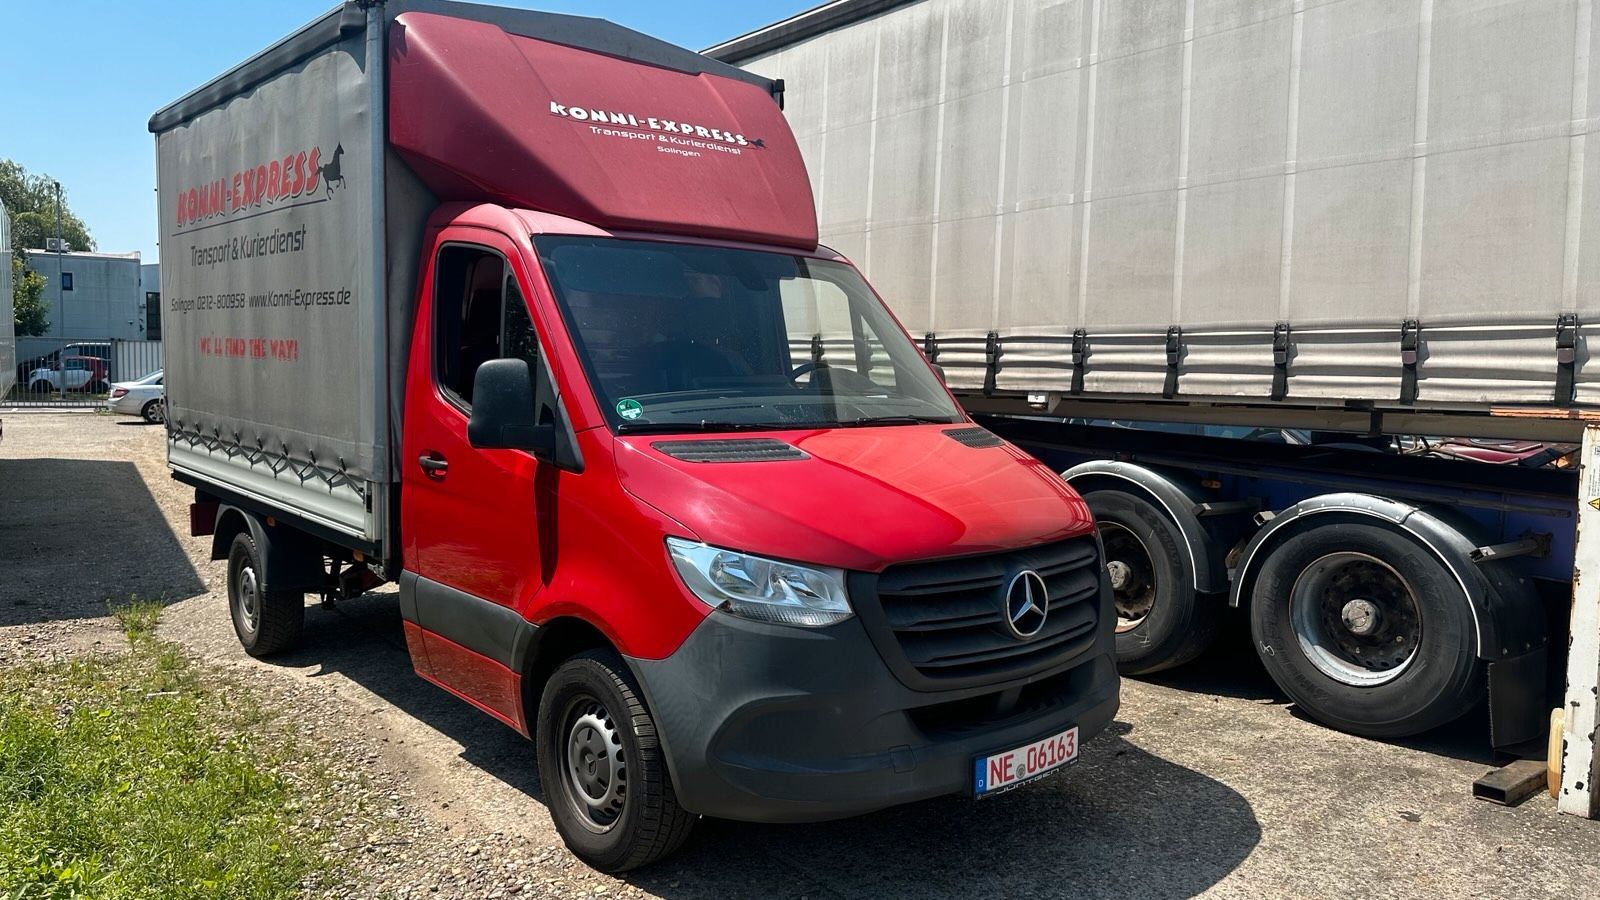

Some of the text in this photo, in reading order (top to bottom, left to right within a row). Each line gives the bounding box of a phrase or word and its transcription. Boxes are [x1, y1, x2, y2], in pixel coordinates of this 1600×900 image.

[550, 100, 751, 146] KONNI-EXPRESS
[589, 125, 742, 155] Transport & Kurierdienst
[656, 145, 701, 158] Solingen
[176, 145, 322, 228] KONNI-EXPRESS
[191, 224, 307, 270] Transport & Kurierdienst
[171, 297, 195, 315] Solingen
[248, 286, 351, 311] www.Konni-Express.de
[225, 337, 246, 358] FIND
[248, 338, 267, 359] THE
[270, 339, 299, 362] WAY!
[990, 731, 1075, 787] NE 06163
[978, 779, 984, 788] D
